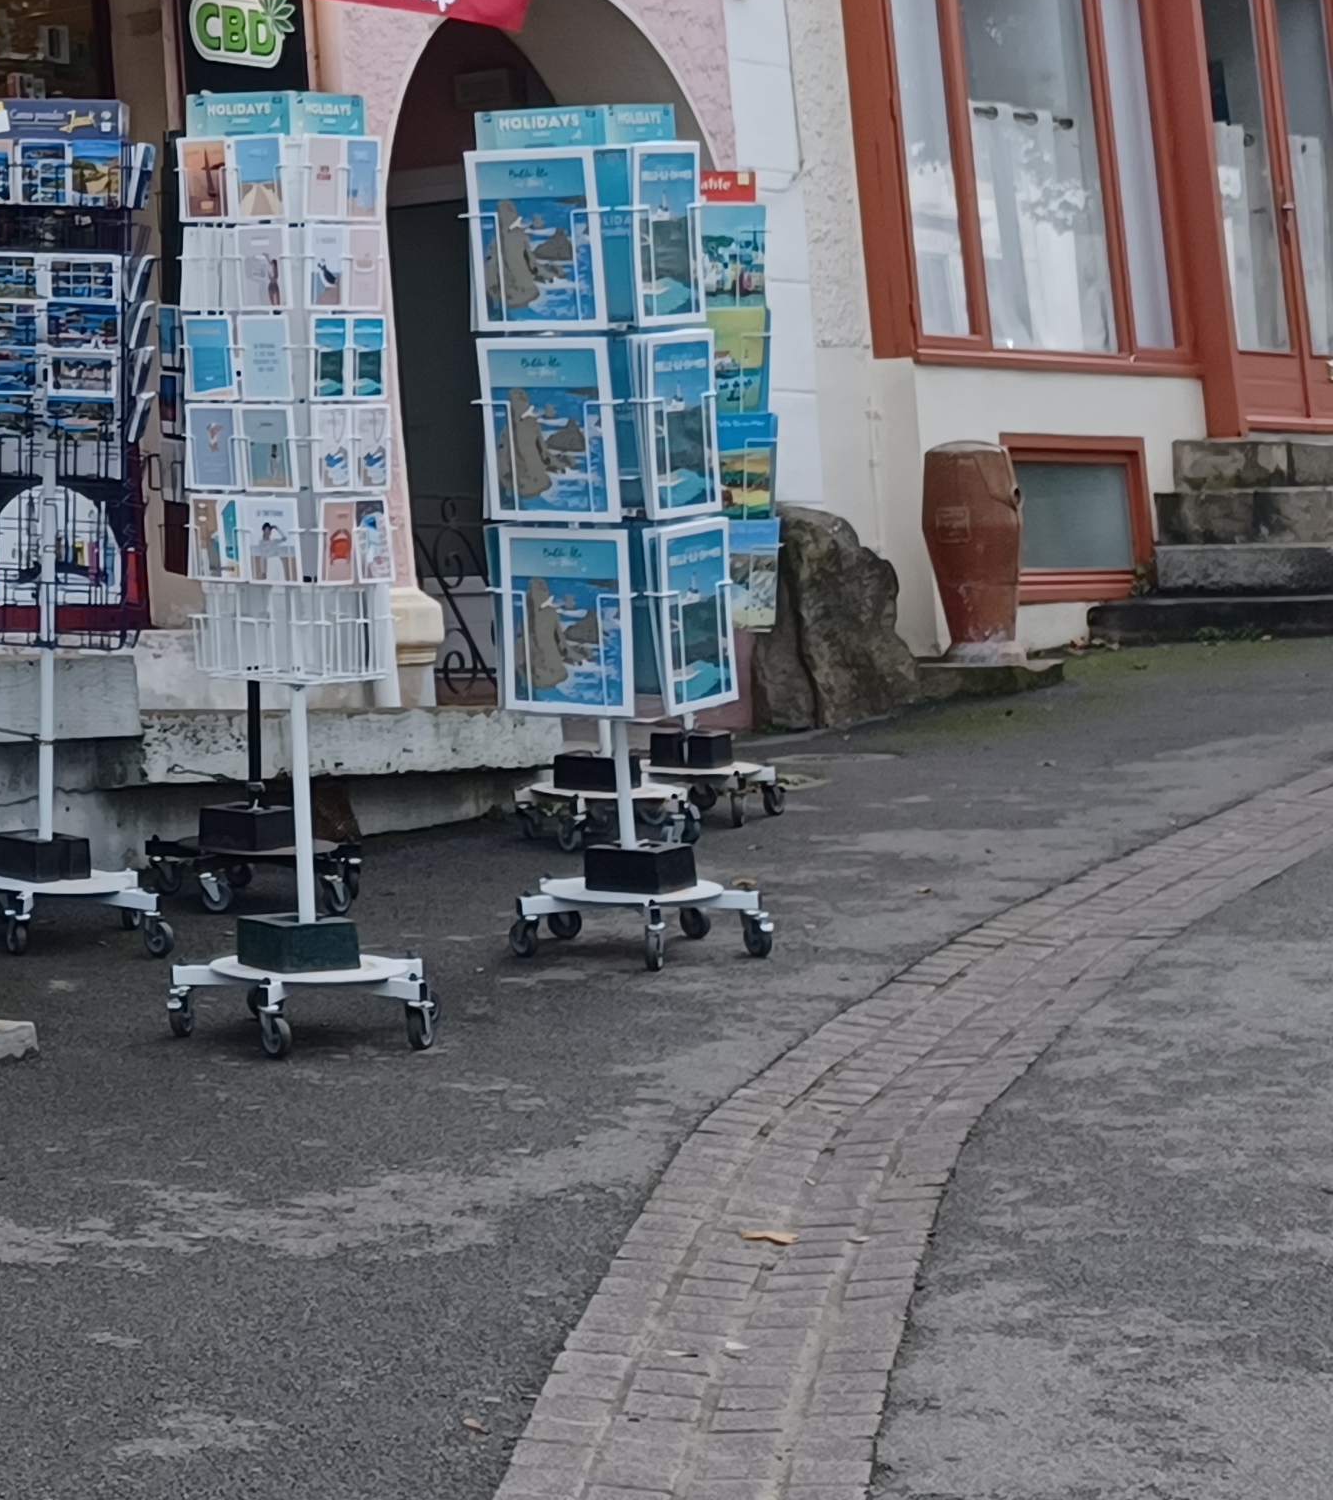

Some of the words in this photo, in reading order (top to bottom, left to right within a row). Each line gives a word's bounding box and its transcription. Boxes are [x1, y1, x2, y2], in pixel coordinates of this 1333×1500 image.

[195, 1, 277, 56] CBD
[206, 102, 272, 117] HOLIDAYS
[305, 103, 352, 116] HOLIDAYS
[498, 113, 580, 130] HOLIDAYS
[616, 111, 662, 125] HOLIDAYS
